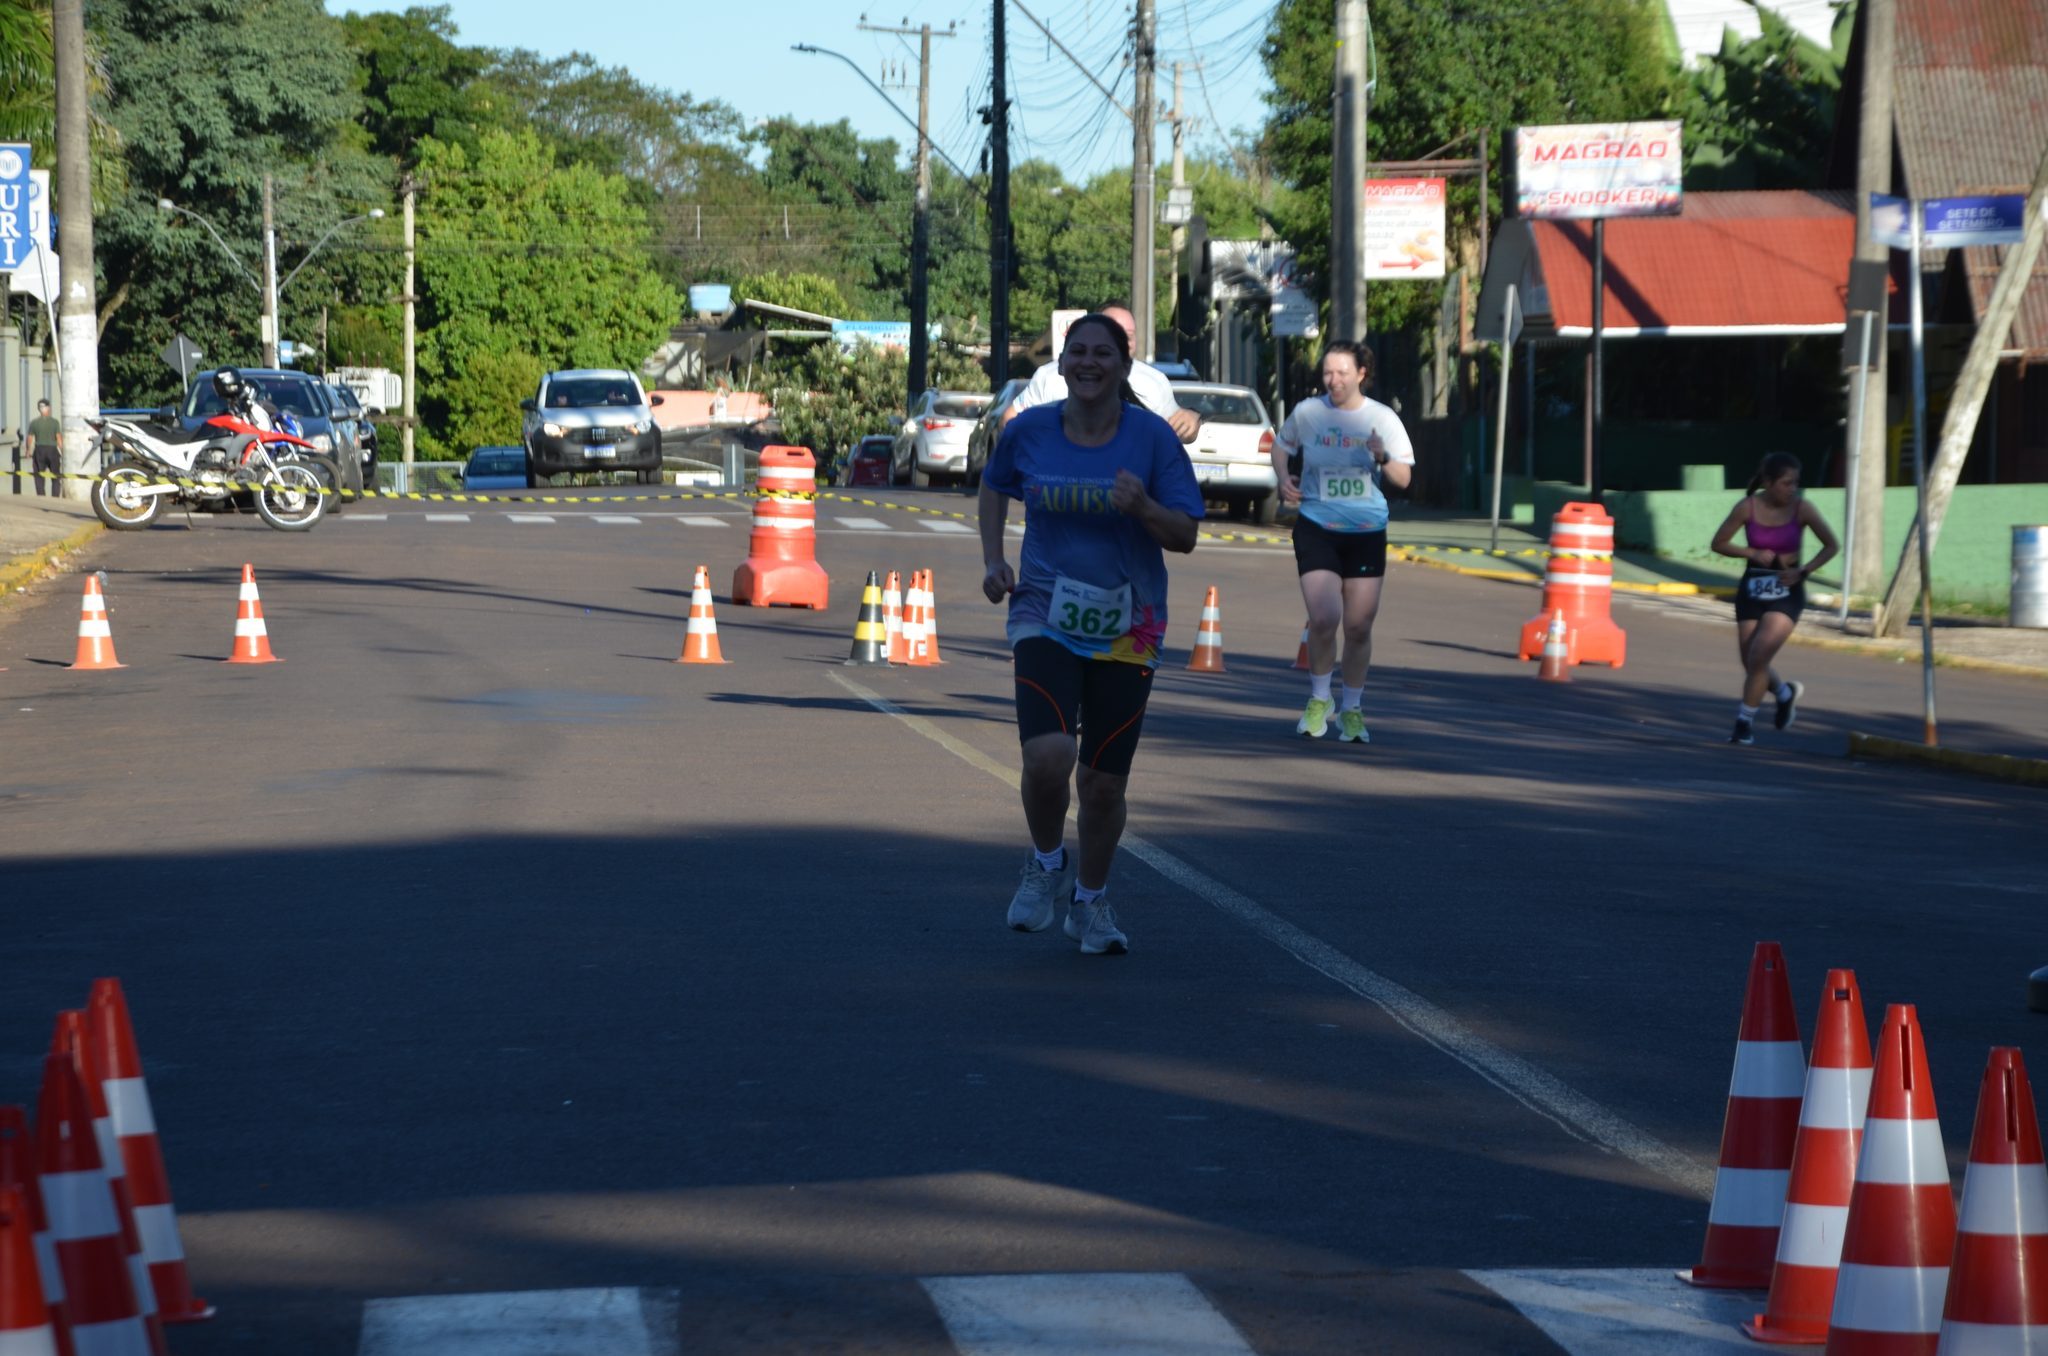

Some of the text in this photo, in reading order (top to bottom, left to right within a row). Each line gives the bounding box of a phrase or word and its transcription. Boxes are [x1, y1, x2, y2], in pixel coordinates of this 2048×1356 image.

[1534, 134, 1669, 162] MAGRÃO
[1547, 189, 1657, 206] SNOOKER
[1947, 206, 1995, 218] SETE DE
[0, 184, 21, 265] URI
[1938, 217, 2004, 230] SETEMBRO
[1327, 478, 1365, 498] 509
[1058, 601, 1122, 635] 362
